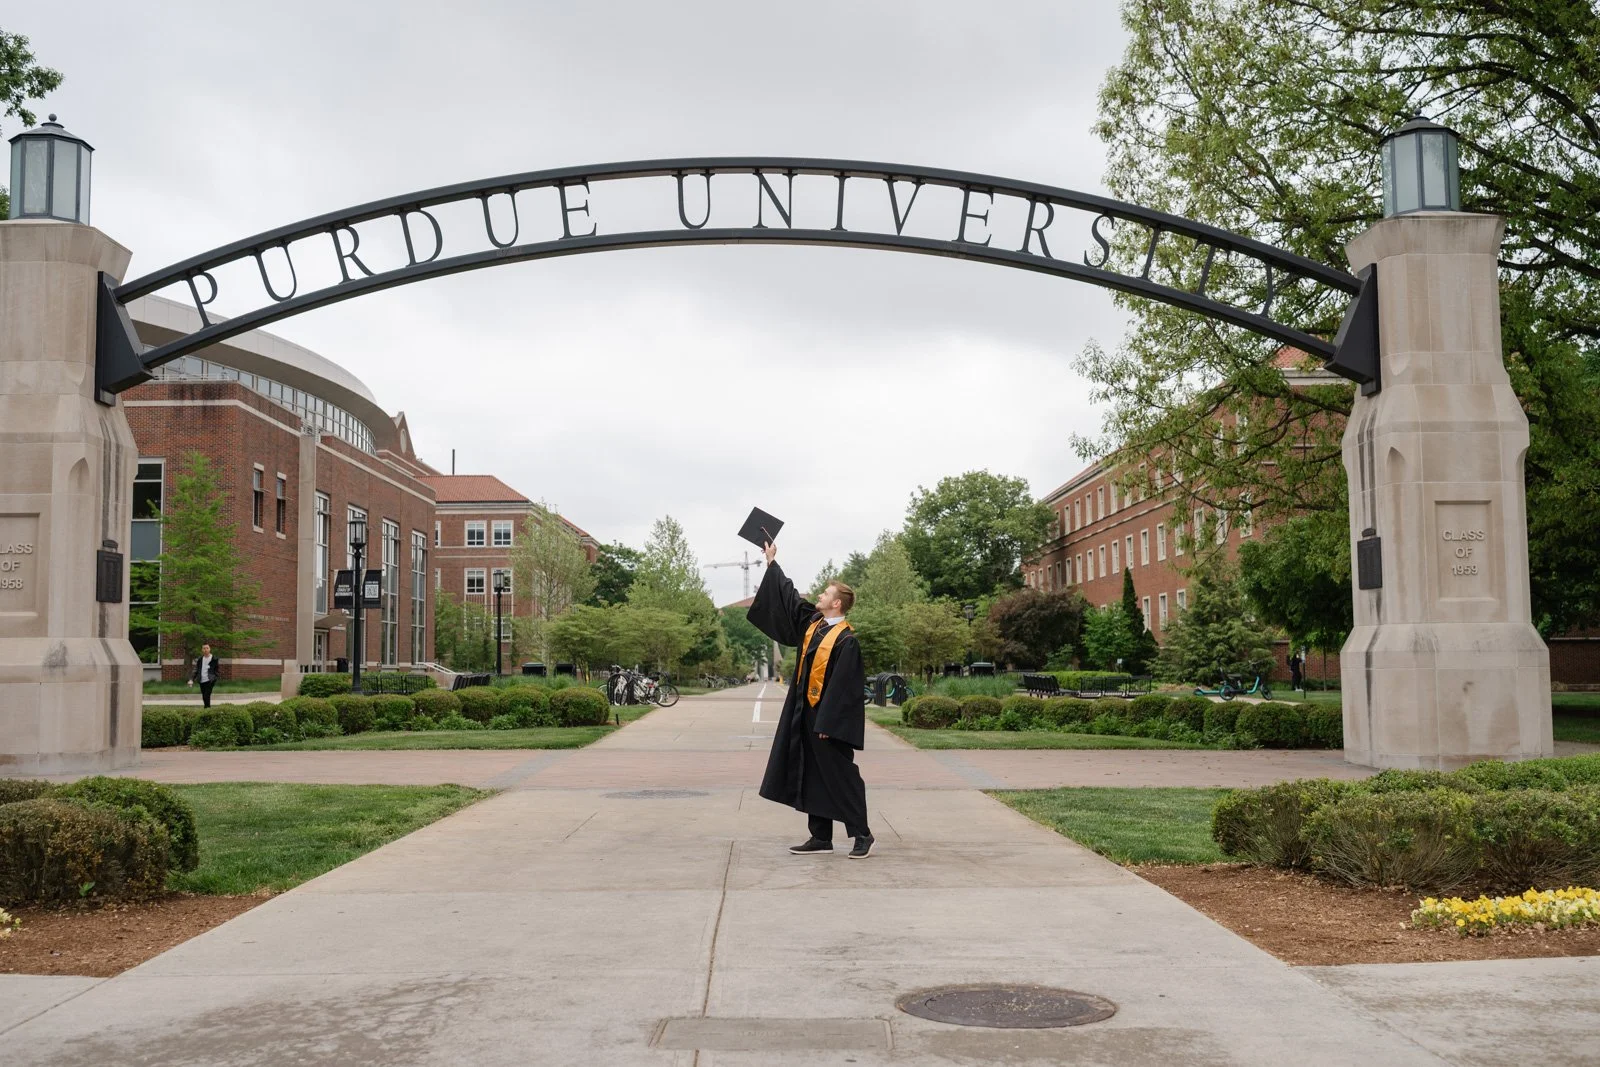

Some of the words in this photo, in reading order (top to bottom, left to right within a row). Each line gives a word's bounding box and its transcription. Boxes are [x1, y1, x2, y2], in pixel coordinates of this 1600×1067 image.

[182, 179, 598, 328] PURDUE
[671, 169, 1293, 317] UNIVERSITY
[1443, 529, 1485, 541] CLASS
[0, 543, 33, 555] LASS
[1455, 547, 1473, 558] OF
[1, 560, 21, 572] OF
[1452, 564, 1478, 575] 1959
